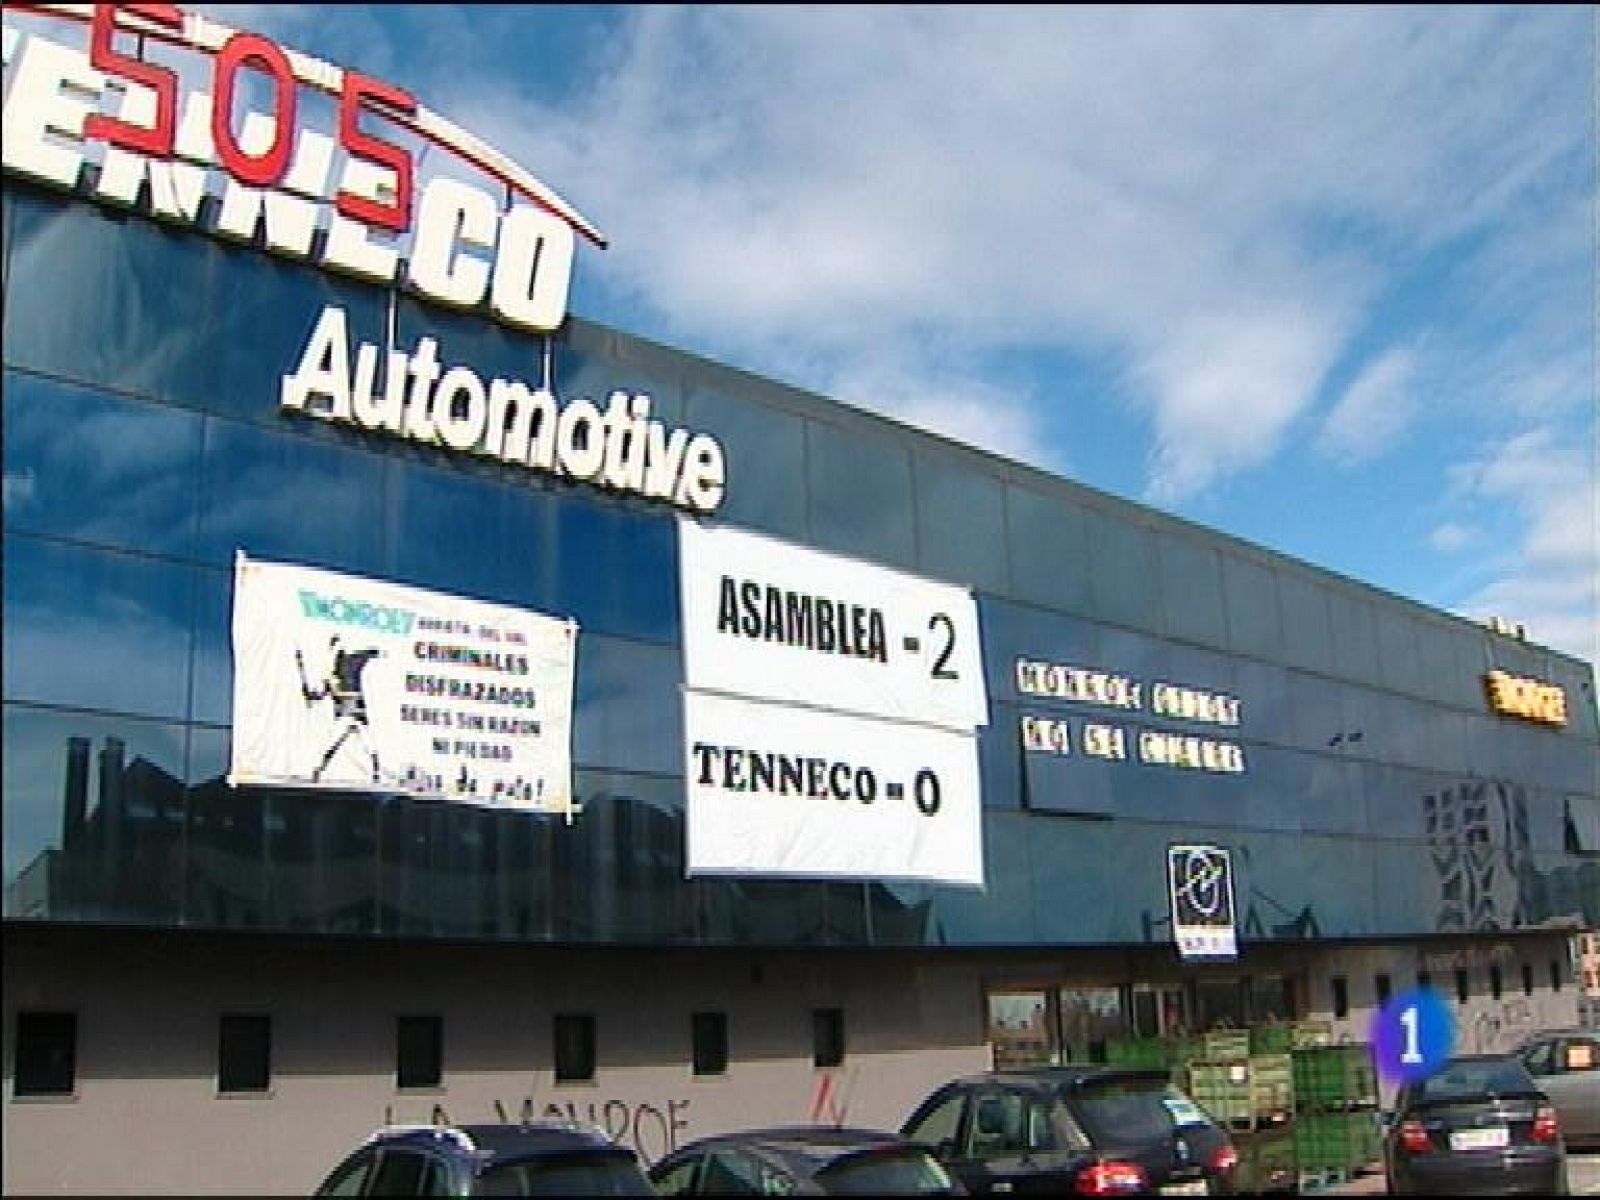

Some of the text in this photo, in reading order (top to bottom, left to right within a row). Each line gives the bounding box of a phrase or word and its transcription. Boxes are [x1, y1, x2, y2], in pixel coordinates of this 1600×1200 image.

[281, 304, 726, 512] Automotive
[717, 574, 888, 664] ASAMBLEA
[928, 612, 960, 680] 2
[414, 641, 529, 676] CRIMINALES
[405, 674, 536, 709] DISFRAZADOS
[400, 703, 452, 727] SERES
[456, 711, 484, 733] SIN
[453, 741, 513, 764] PIEDAD
[693, 741, 877, 805] TENNECO
[914, 767, 942, 818] 0
